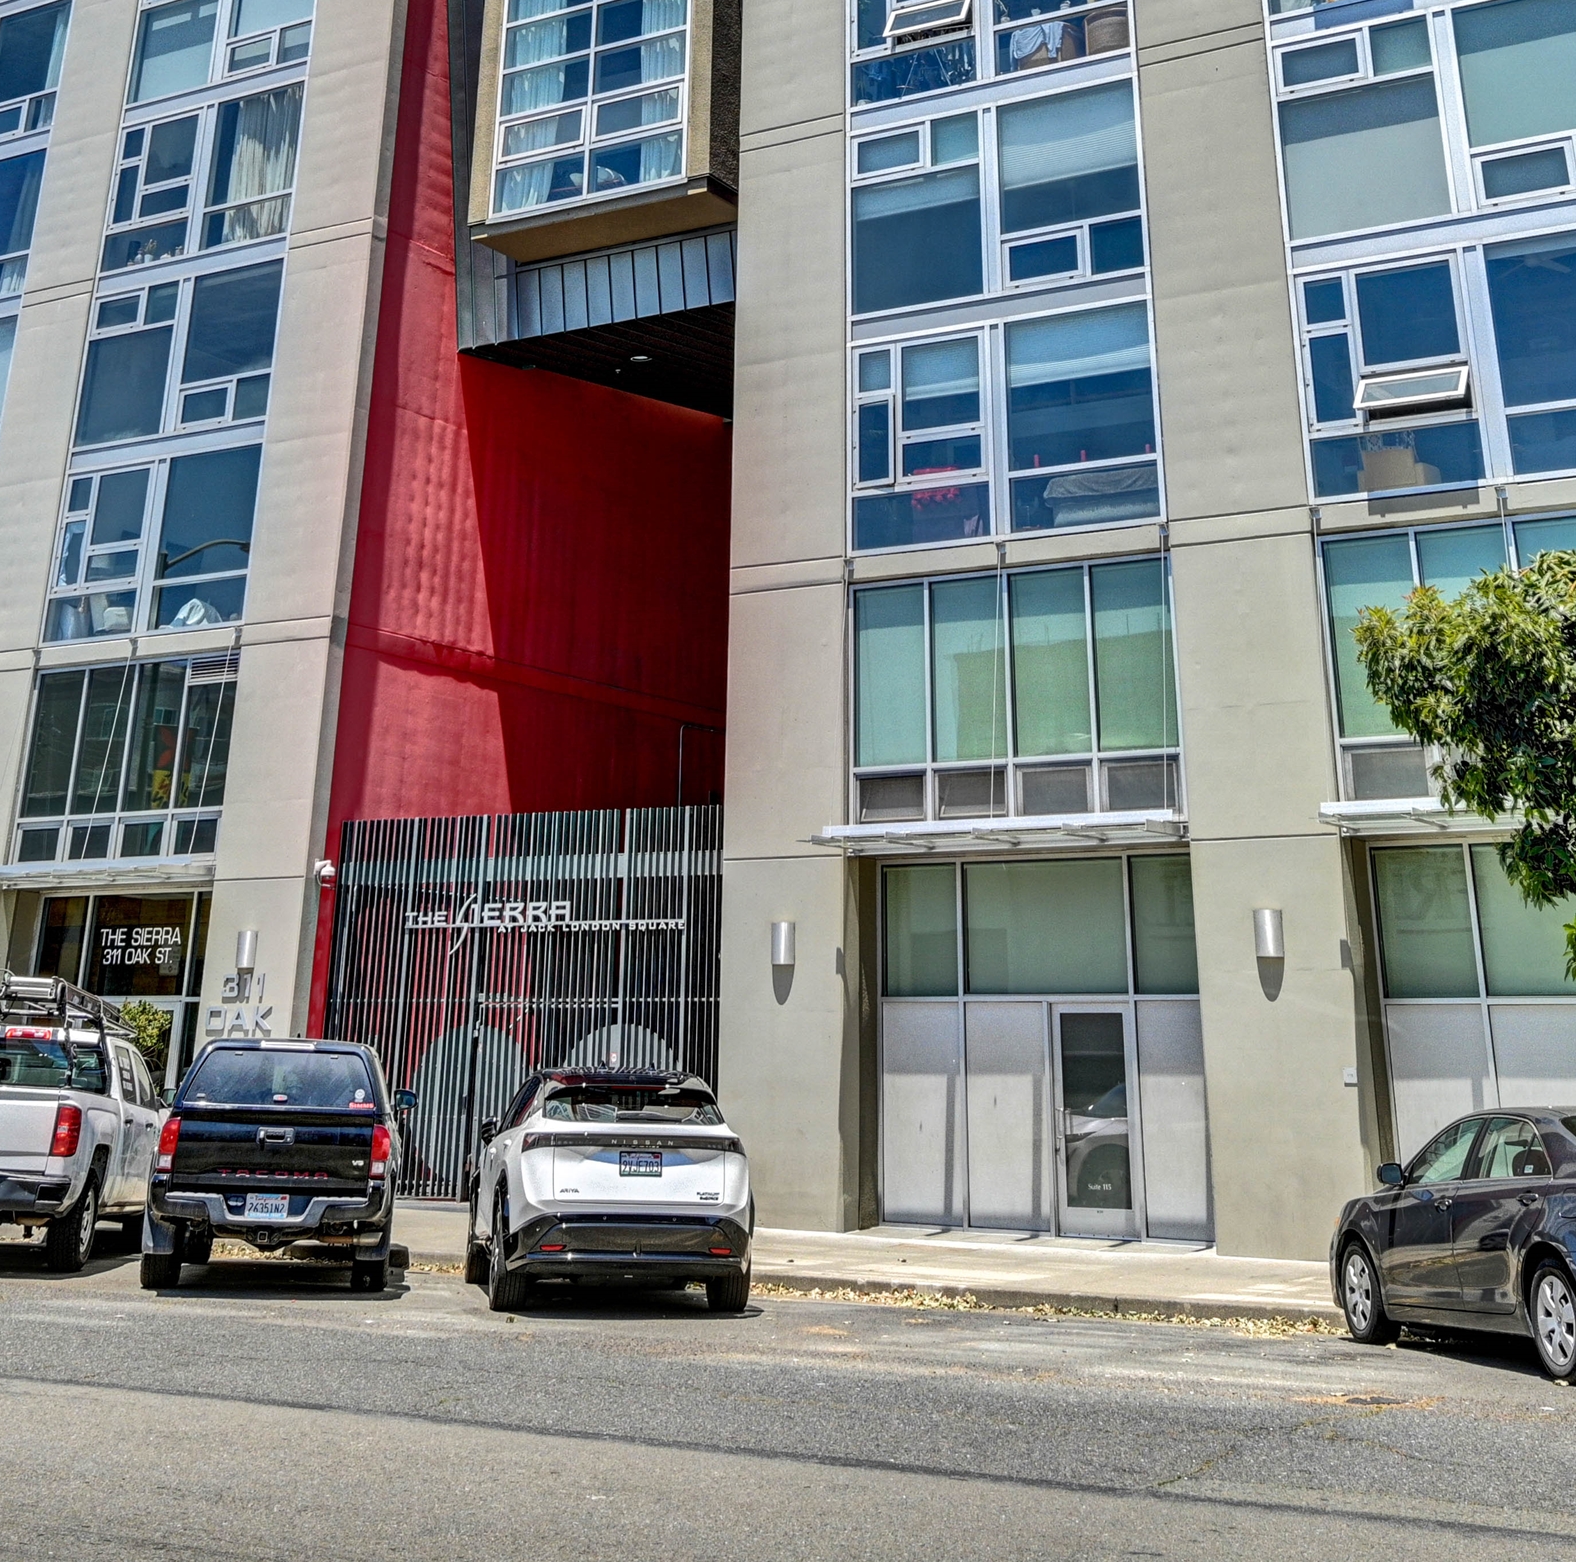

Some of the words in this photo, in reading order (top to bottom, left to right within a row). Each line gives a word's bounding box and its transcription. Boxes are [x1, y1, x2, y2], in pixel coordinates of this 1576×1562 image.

[405, 911, 448, 926] THE
[449, 893, 571, 954] SIERRA
[498, 924, 513, 933] AT
[521, 923, 555, 932] JACK
[562, 922, 620, 931] LONDON
[628, 921, 685, 932] SQUARE
[101, 928, 127, 946] THE
[131, 927, 181, 946] SIERRA
[102, 948, 121, 965] 311
[124, 948, 152, 965] OAK
[155, 948, 173, 964] ST.
[222, 973, 264, 998] 311
[206, 1006, 273, 1031] OAK
[217, 1168, 329, 1180] TACOMA
